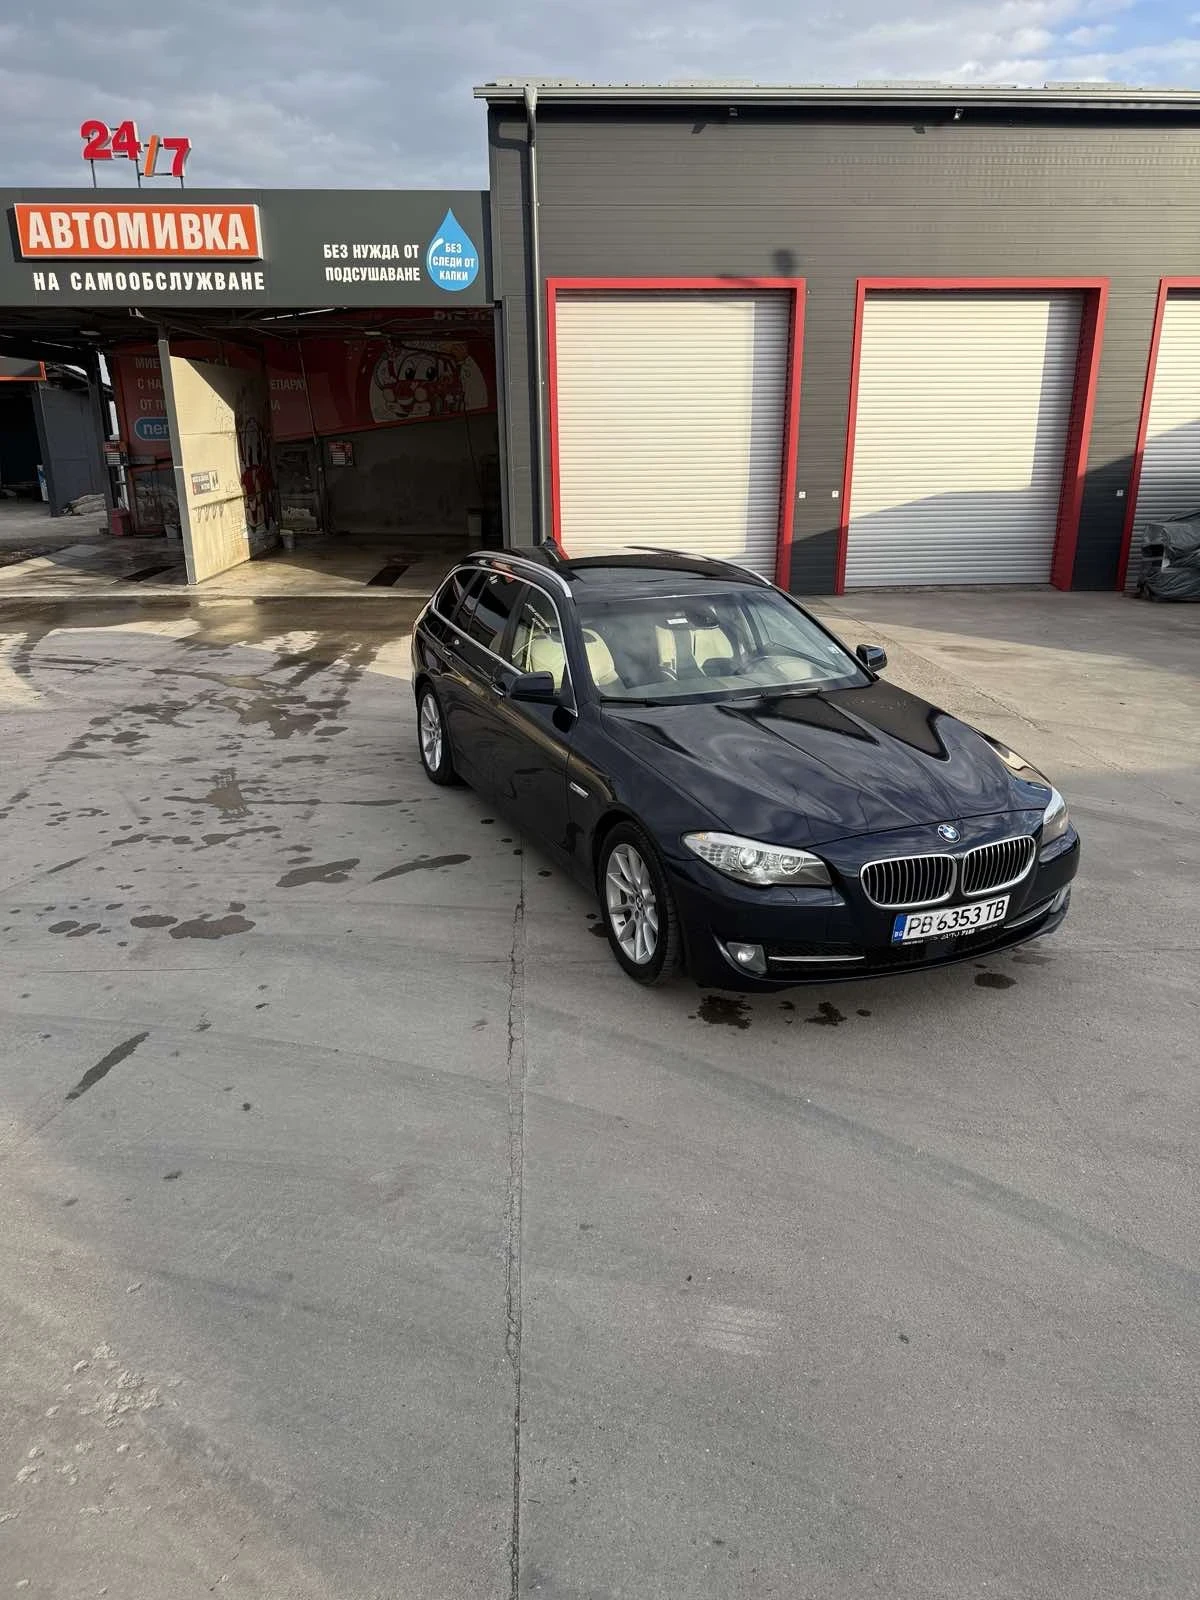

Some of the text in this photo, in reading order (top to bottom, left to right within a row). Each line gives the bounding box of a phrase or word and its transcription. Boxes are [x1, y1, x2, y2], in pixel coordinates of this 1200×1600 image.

[80, 119, 191, 177] 24/7
[29, 211, 250, 250] АВТОМИВКА
[323, 244, 419, 260] БЕЗ НУЖДА ОТ
[445, 243, 462, 254] БЕЗ
[432, 256, 475, 268] СЛЕДИ ОТ
[33, 272, 265, 291] НА САМООБСЛУЖВАНЕ
[325, 267, 420, 282] ПОДСУШАВАНЕ
[439, 270, 469, 281] КАПКИ
[936, 906, 982, 931] 6353
[986, 900, 1005, 921] TB
